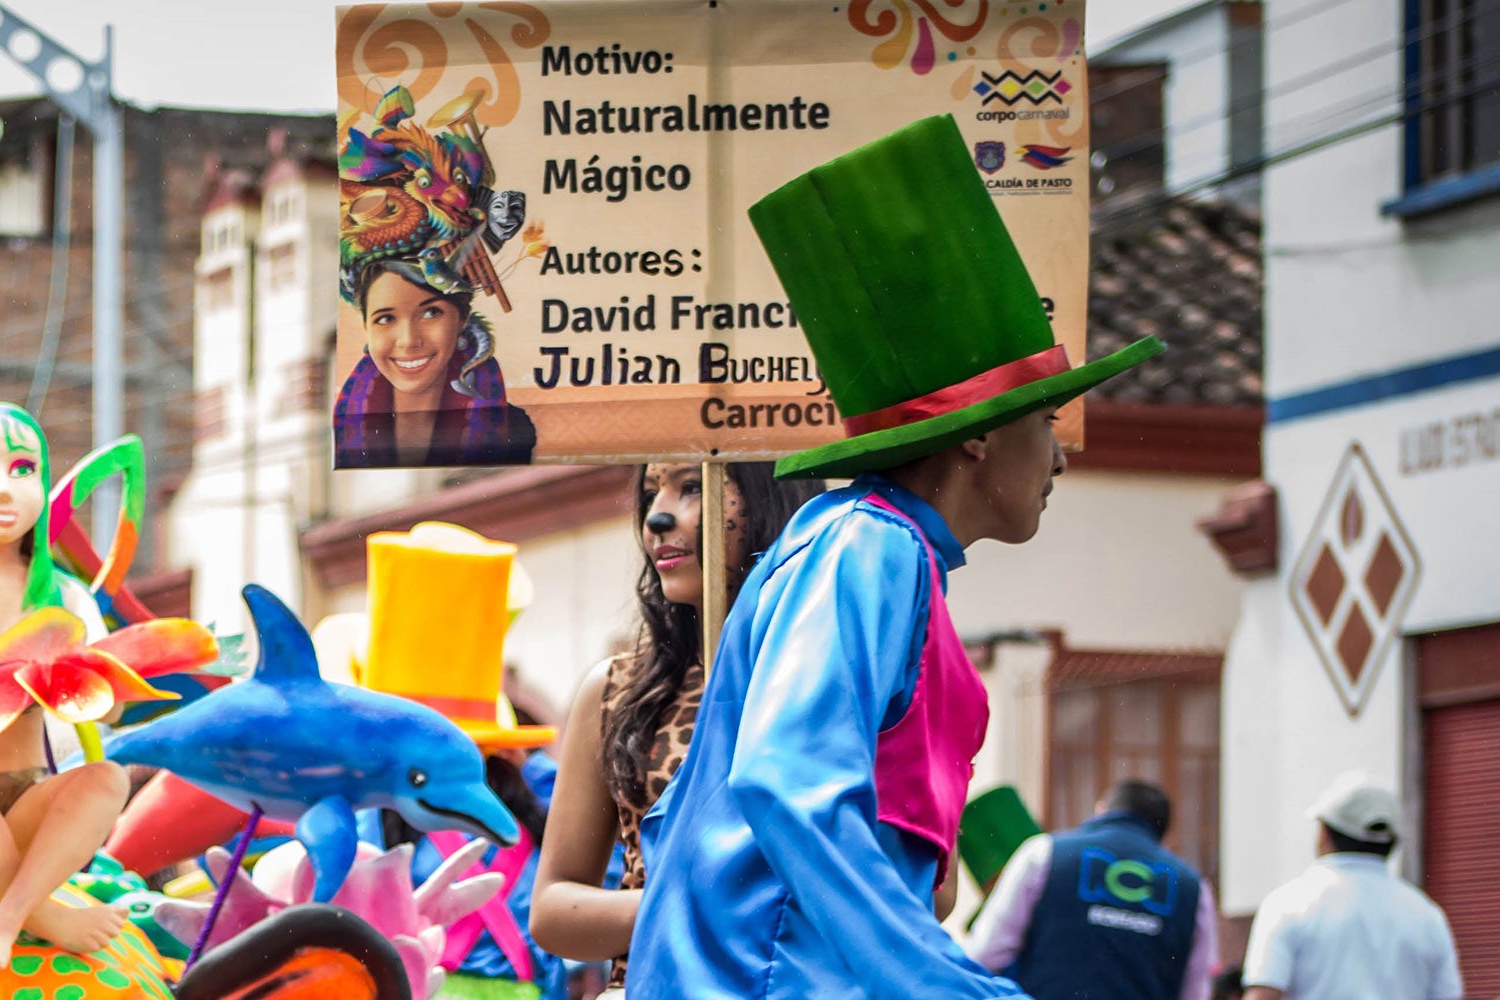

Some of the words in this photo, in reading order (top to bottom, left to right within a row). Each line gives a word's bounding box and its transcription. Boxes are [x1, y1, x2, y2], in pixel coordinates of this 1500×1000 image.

[541, 43, 674, 76] Motivo:
[543, 94, 830, 136] Naturalmente
[976, 107, 1070, 124] corpocarnaval
[543, 155, 691, 202] Mágico
[985, 177, 1023, 188] CALDÍA
[1026, 179, 1038, 188] DE
[1041, 178, 1073, 187] PASTO
[540, 246, 702, 276] Autores:
[541, 295, 655, 334] David
[533, 344, 681, 390] Julian
